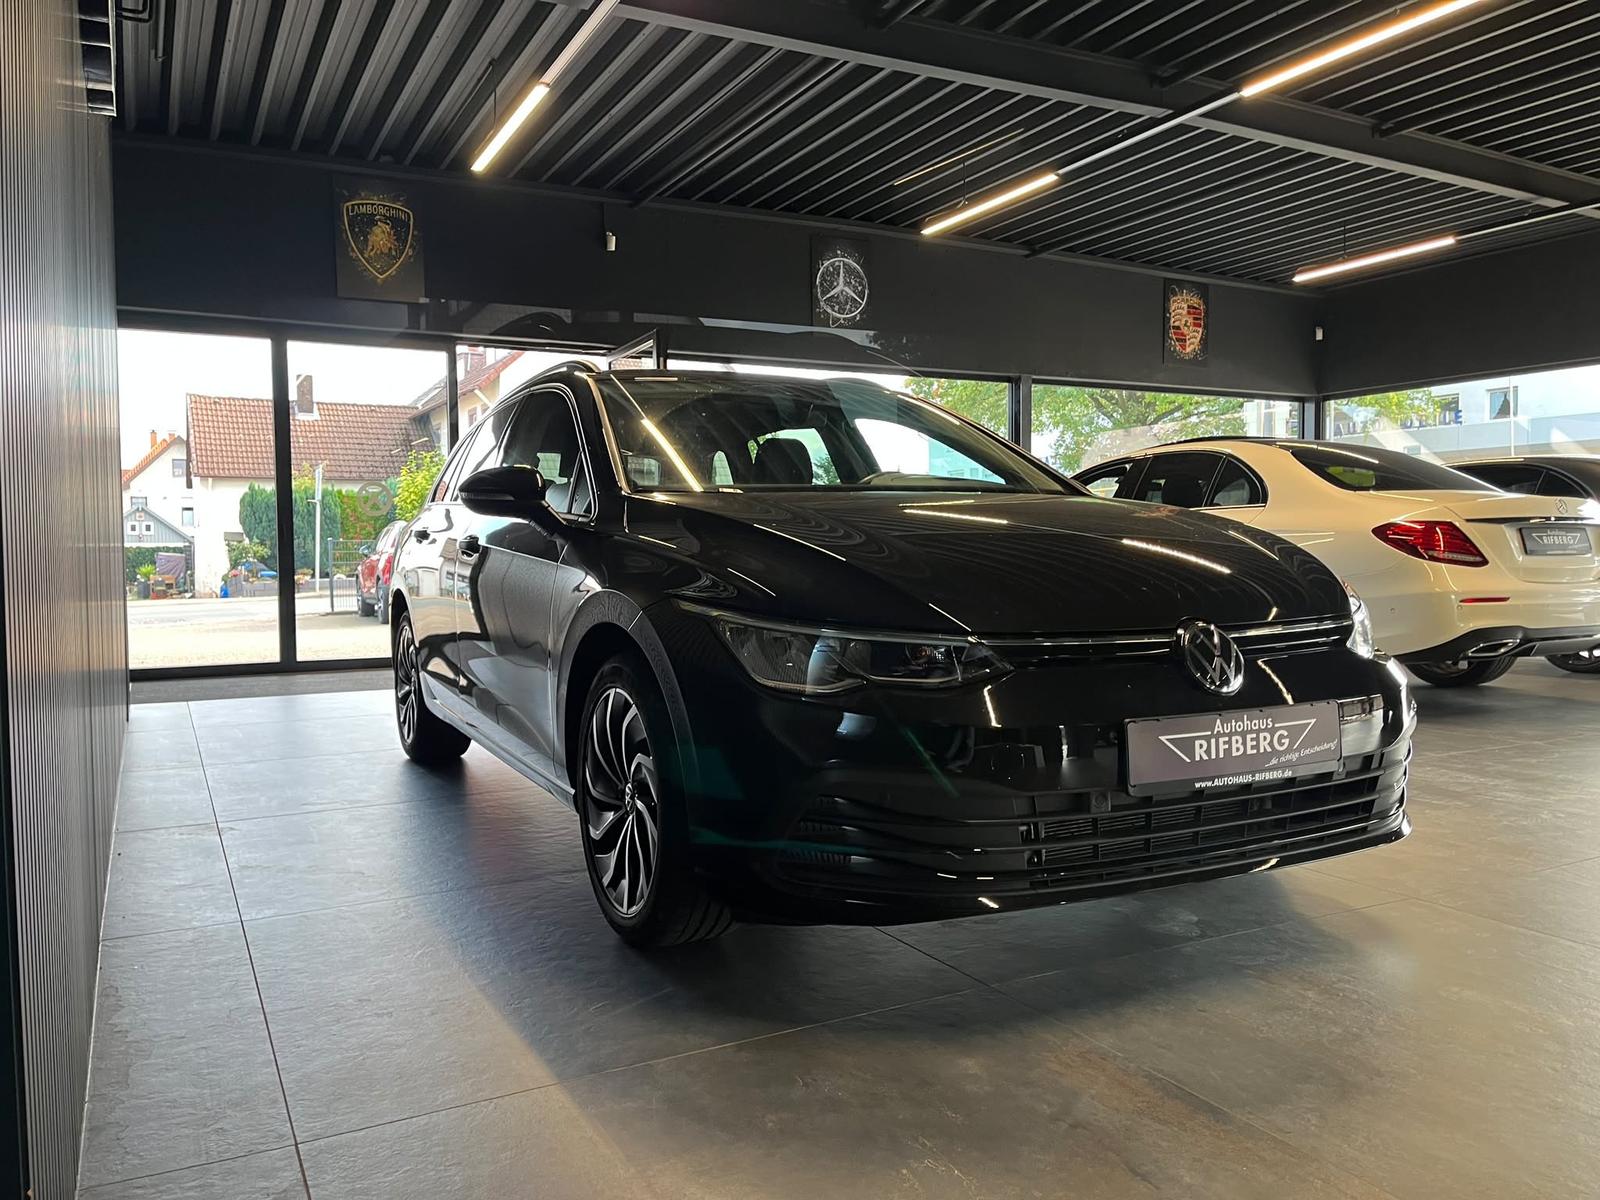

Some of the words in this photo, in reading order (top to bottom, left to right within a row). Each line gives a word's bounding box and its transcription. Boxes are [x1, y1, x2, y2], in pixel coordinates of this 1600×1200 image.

[348, 204, 408, 222] LAMBORGHINI
[1542, 535, 1574, 545] RIFBERG
[1213, 714, 1273, 734] Autohaus
[1194, 729, 1290, 761] RIFBERG
[1194, 769, 1293, 789] www.AUTOHAUS-RIFBERG.de
